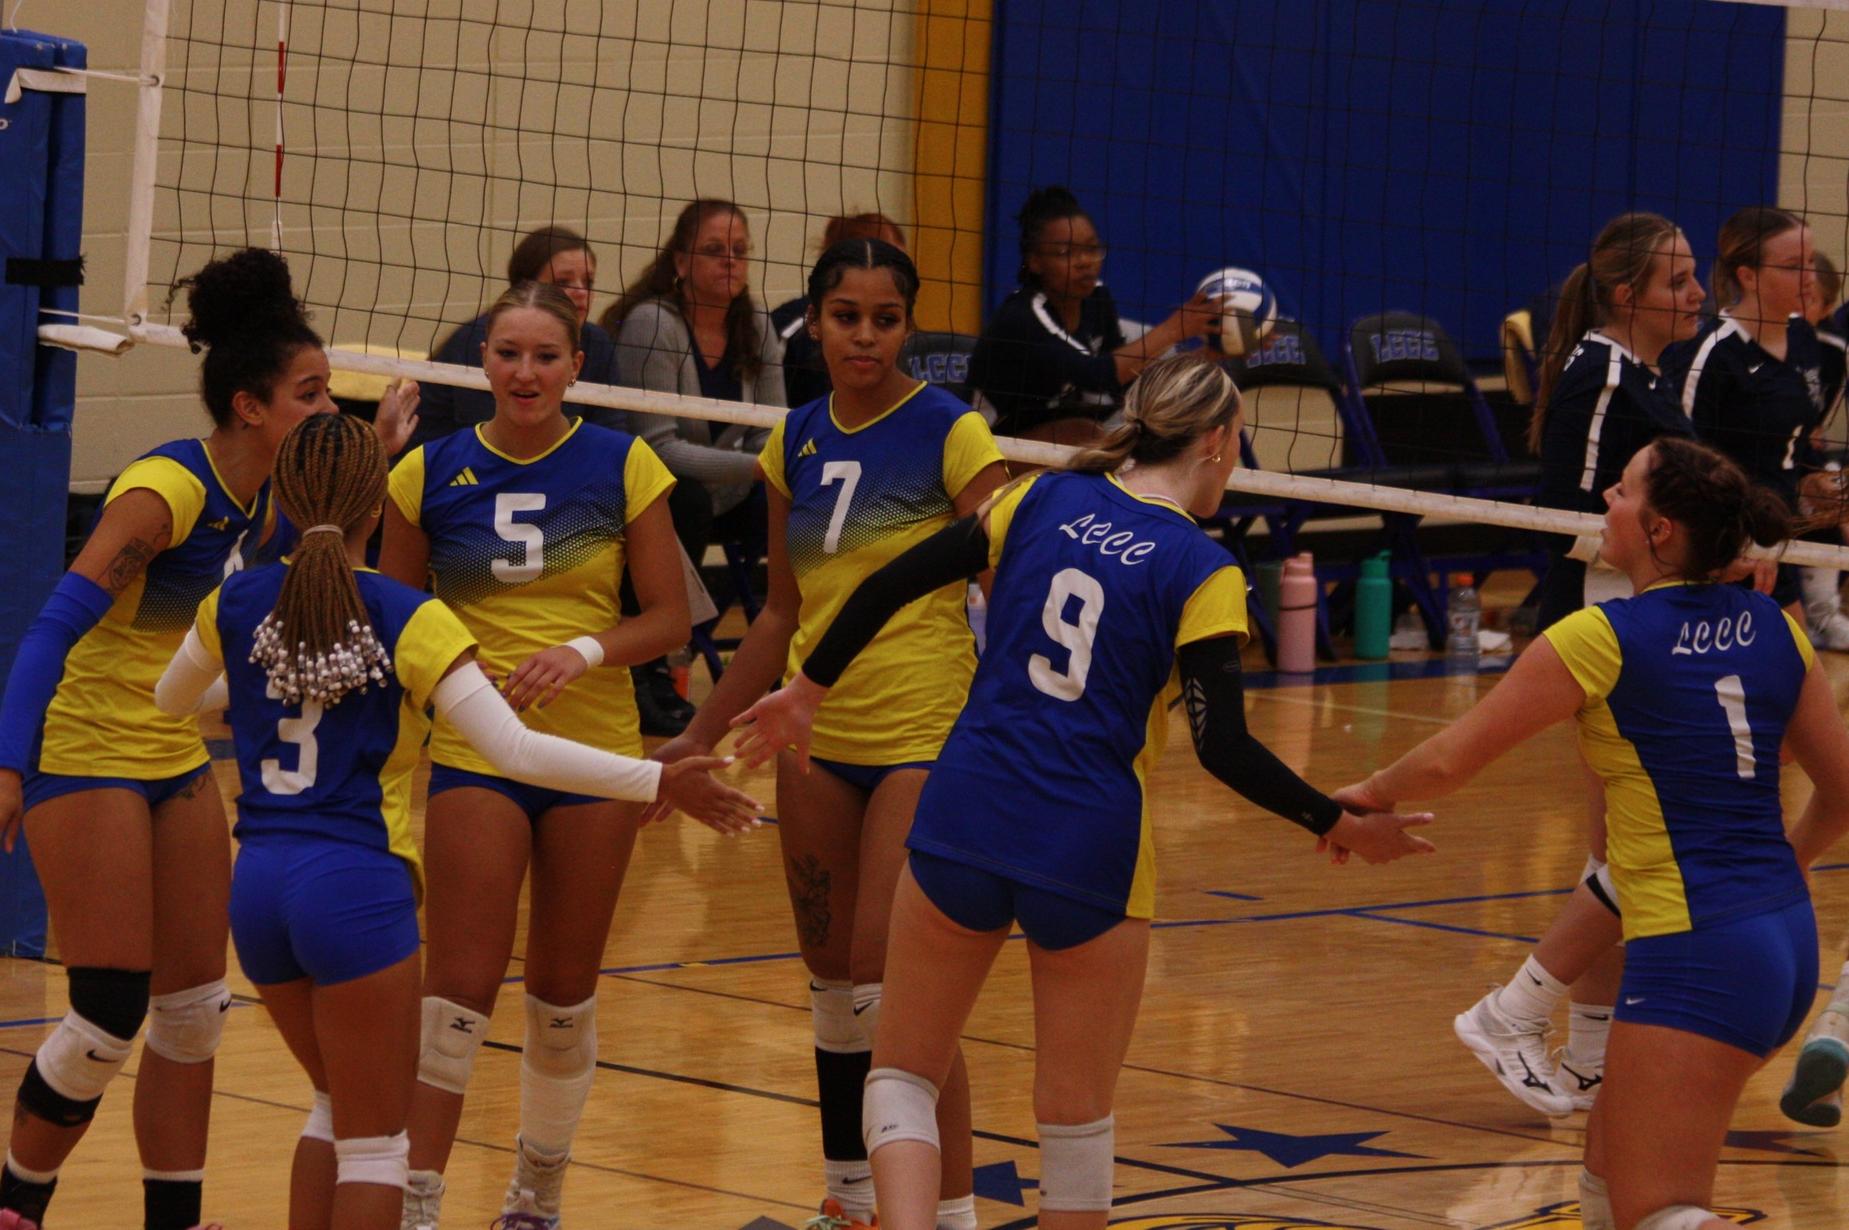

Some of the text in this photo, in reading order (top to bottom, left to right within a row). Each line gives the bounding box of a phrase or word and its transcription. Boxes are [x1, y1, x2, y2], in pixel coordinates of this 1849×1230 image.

[908, 351, 973, 385] LCC
[490, 493, 546, 583] 5
[820, 460, 862, 554] 7
[1059, 513, 1156, 566] LCCC
[1028, 568, 1105, 702] 9
[1671, 610, 1757, 656] LCCC
[261, 672, 326, 796] 3
[1714, 674, 1757, 779] 1
